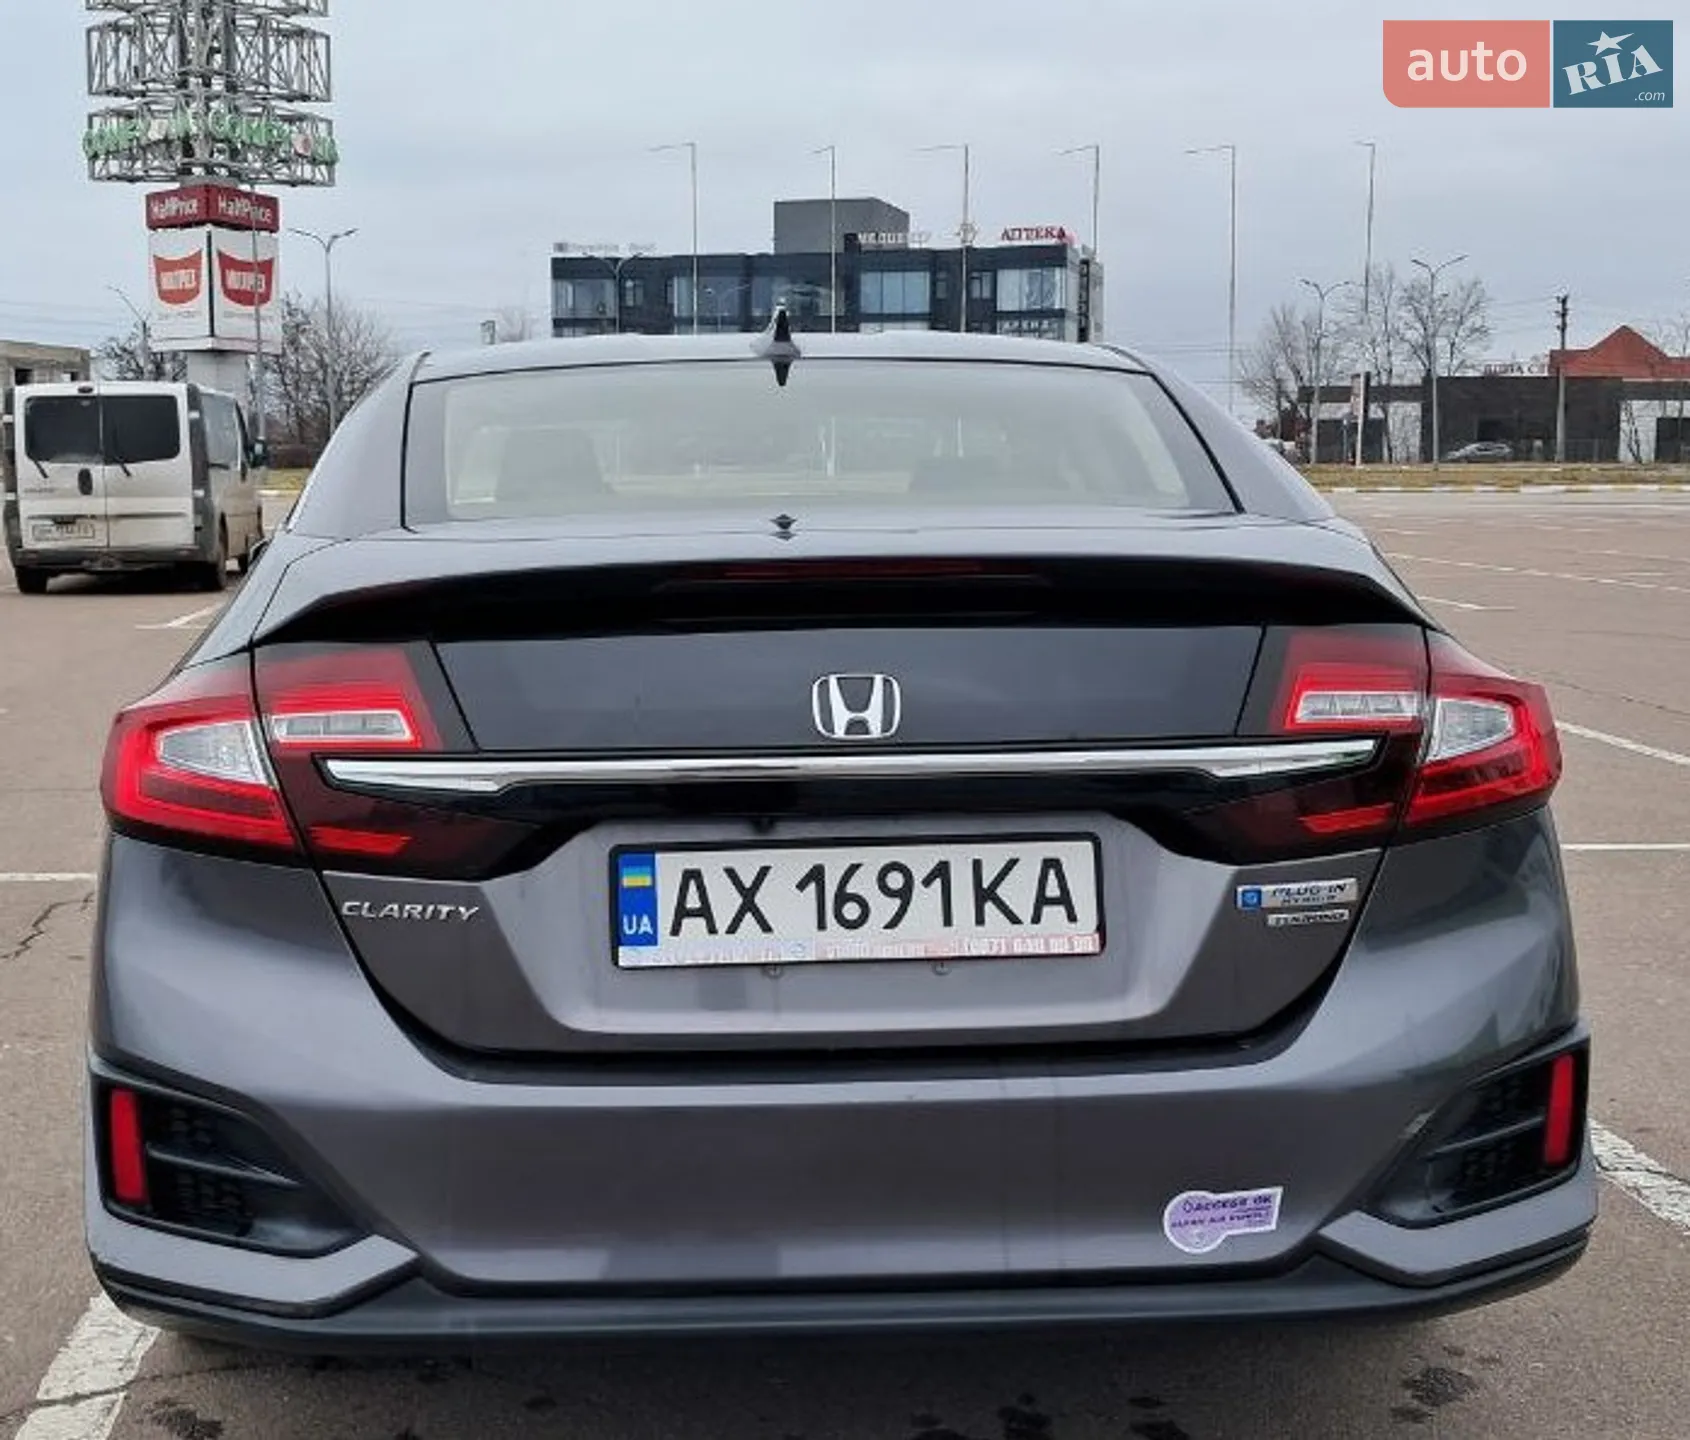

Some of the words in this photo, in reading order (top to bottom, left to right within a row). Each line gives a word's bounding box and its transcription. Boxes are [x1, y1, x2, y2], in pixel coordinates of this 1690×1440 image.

[670, 865, 774, 937] AX
[795, 860, 952, 931] 1691
[972, 857, 1078, 927] KA
[341, 901, 480, 921] CLARITY
[622, 914, 654, 936] UA
